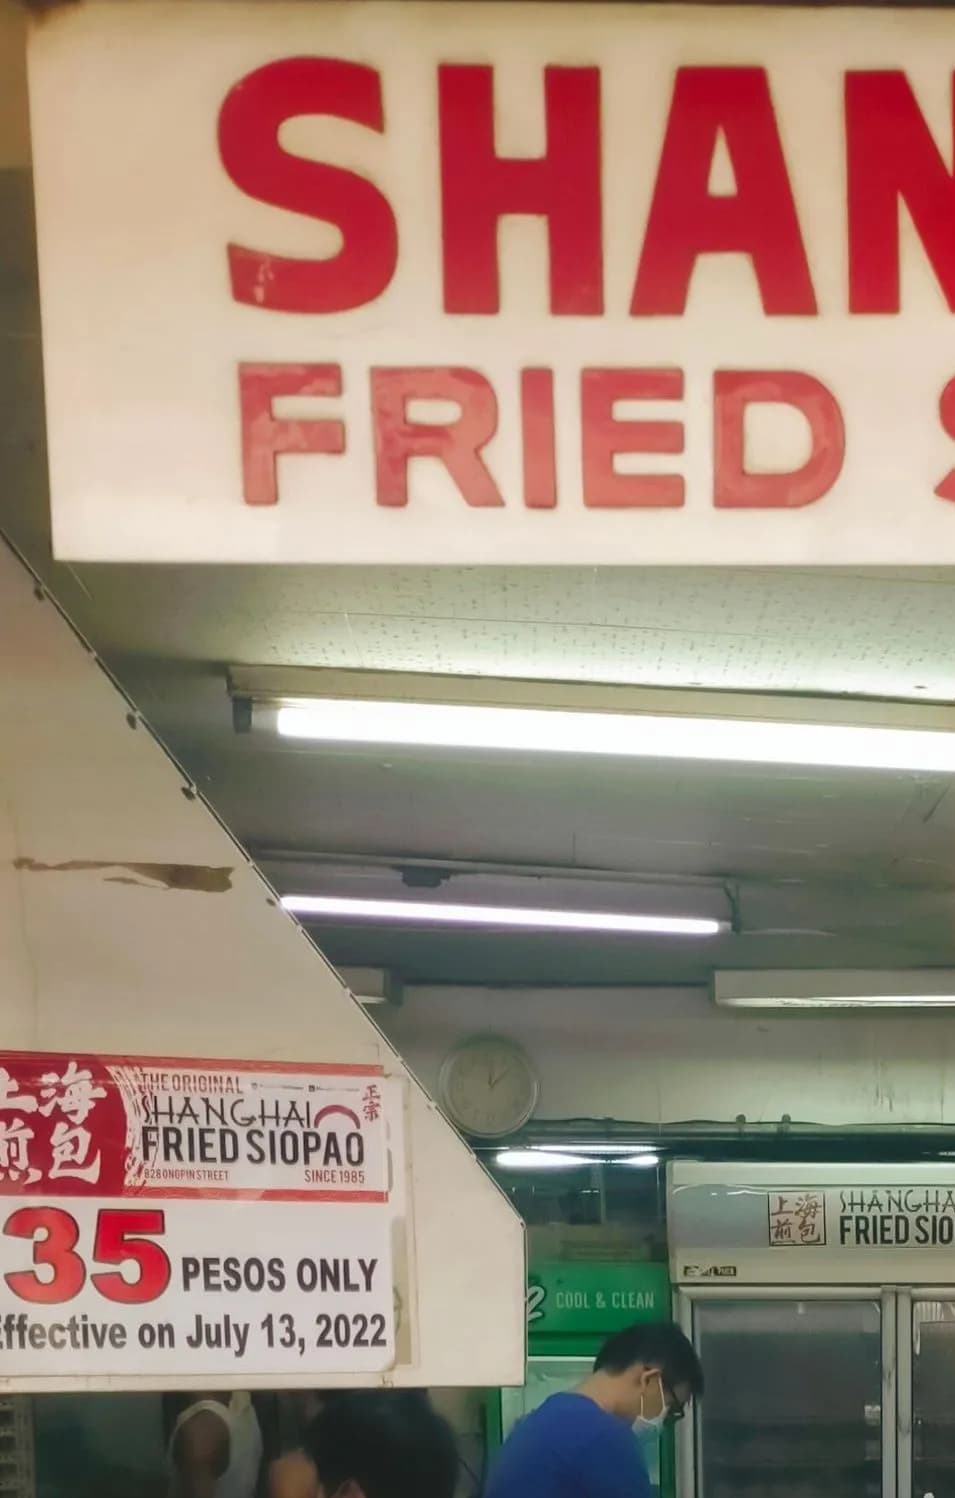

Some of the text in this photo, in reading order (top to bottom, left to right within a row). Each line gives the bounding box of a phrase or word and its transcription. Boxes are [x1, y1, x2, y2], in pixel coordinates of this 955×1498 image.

[238, 362, 845, 509] FRIED
[141, 1072, 244, 1094] THE ORIGINAL
[143, 1095, 310, 1128] SHANGHAI
[142, 1126, 364, 1167] FRIED SIOPAO
[305, 1169, 365, 1184] SINCE 1985
[840, 1215, 910, 1245] FRIED
[2, 1206, 172, 1305] 35
[182, 1257, 379, 1292] PESOS ONLY
[556, 1291, 654, 1309] COOL & CLEAN
[0, 1314, 387, 1357] ffective on July 13, 2022
